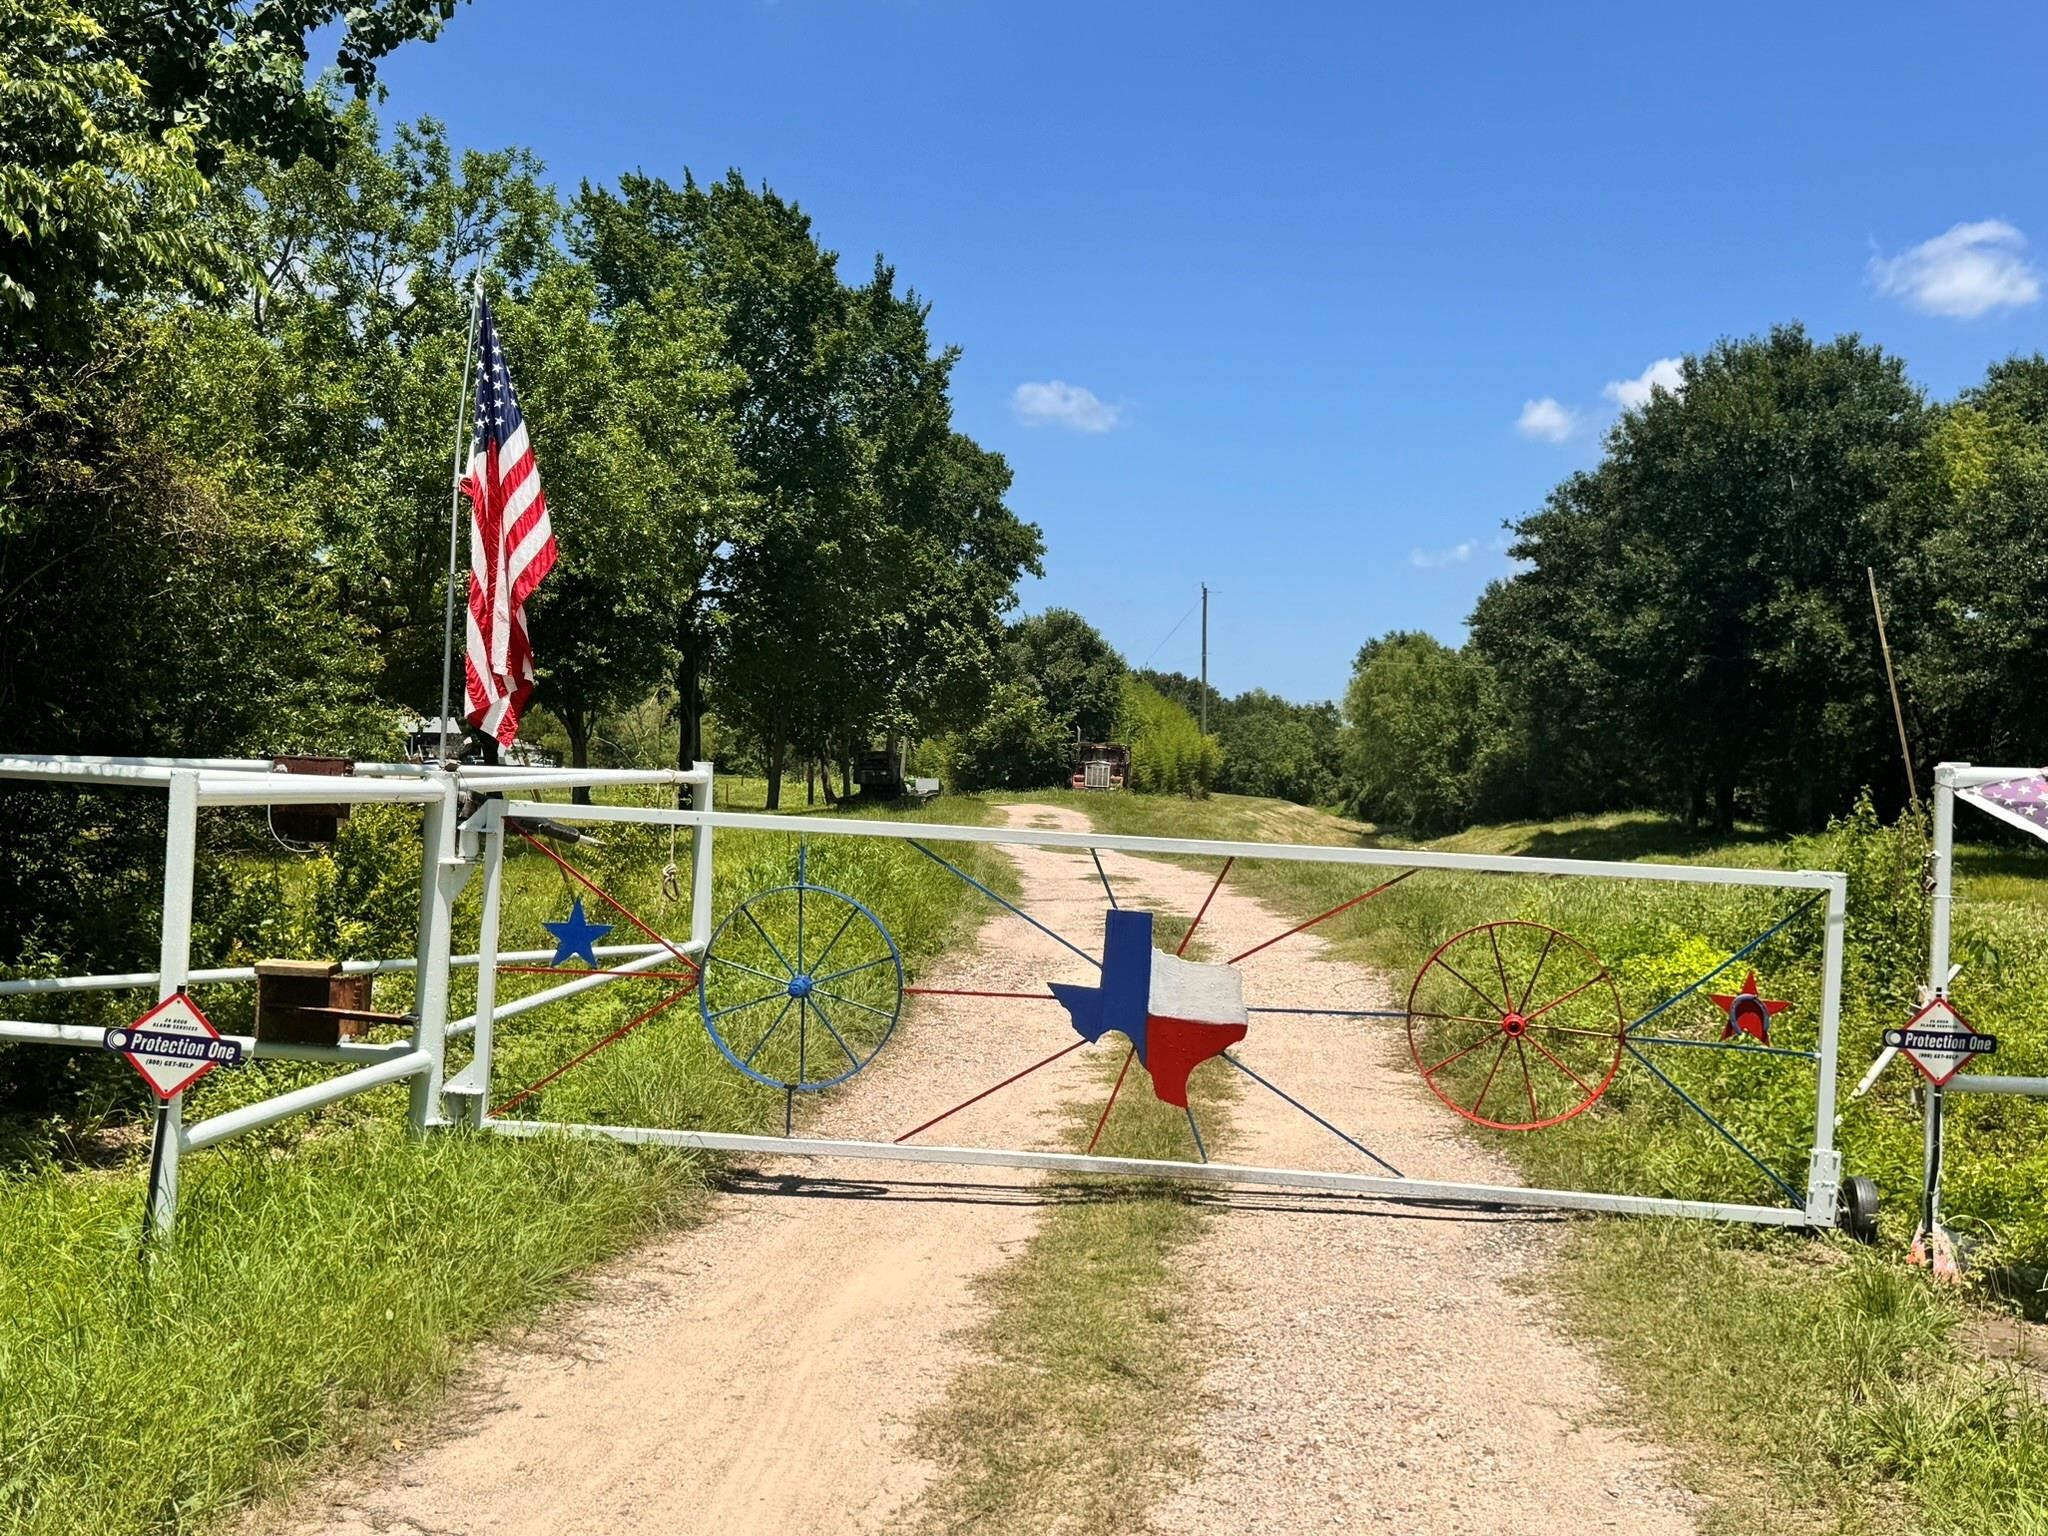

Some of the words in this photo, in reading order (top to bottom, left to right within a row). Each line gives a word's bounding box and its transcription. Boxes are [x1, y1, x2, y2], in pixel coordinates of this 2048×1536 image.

[172, 1024, 198, 1032] SERVICES
[130, 1033, 204, 1057] Protection
[208, 1041, 235, 1059] One
[1905, 1032, 1965, 1049] Protection
[1970, 1036, 1991, 1050] One
